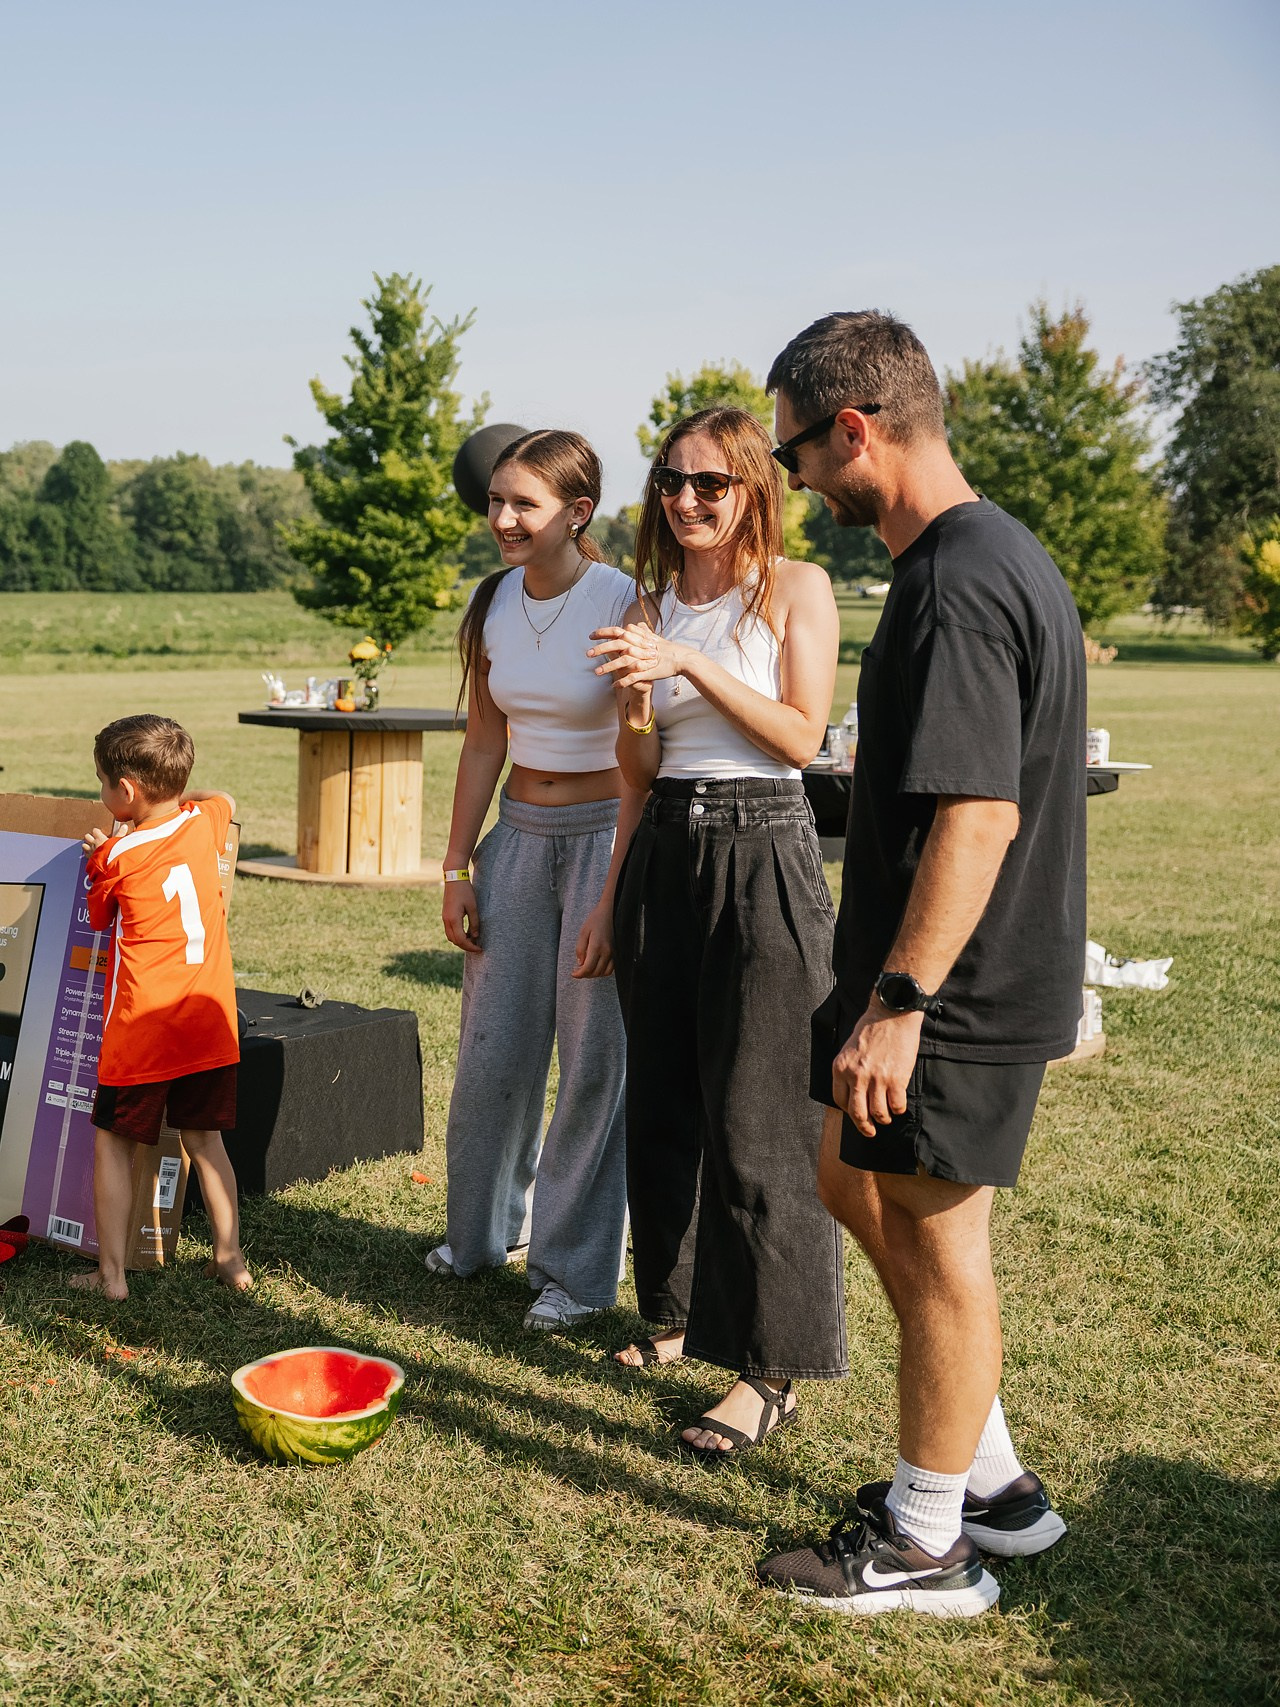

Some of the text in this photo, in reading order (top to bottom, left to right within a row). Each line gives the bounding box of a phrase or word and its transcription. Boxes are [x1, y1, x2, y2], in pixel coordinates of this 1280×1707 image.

[161, 863, 206, 965] 1
[86, 990, 105, 1001] pictur
[155, 1226, 173, 1235] FRONT
